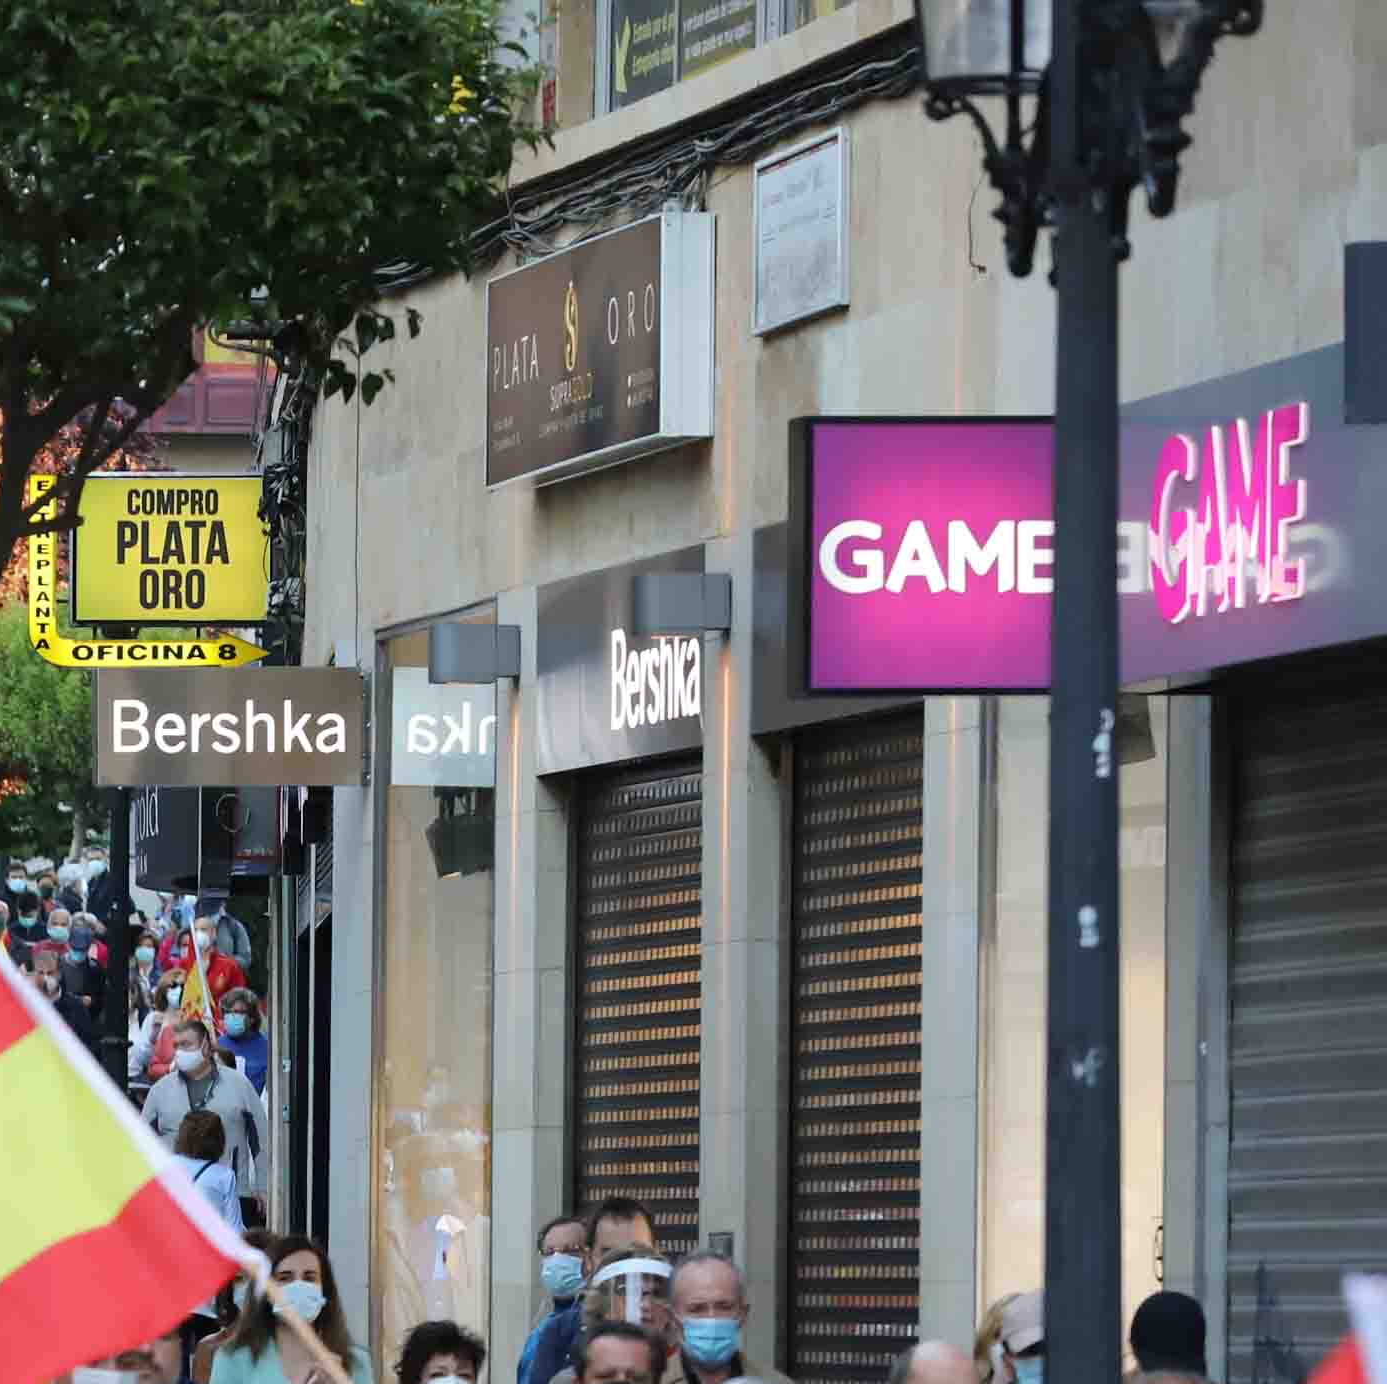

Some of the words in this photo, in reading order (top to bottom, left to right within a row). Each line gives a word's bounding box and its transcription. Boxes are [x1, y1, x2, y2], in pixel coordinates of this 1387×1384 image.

[493, 329, 540, 392] PLATA
[607, 284, 655, 345] ORO
[127, 489, 219, 515] COMPRO
[1151, 400, 1310, 625] GAME
[117, 520, 229, 565] PLATA
[819, 519, 1055, 595] GAME
[139, 569, 205, 610] ORO
[72, 644, 206, 661] OFICINA
[218, 644, 237, 660] 8
[610, 628, 701, 731] Bershka
[112, 698, 347, 754] Bershka
